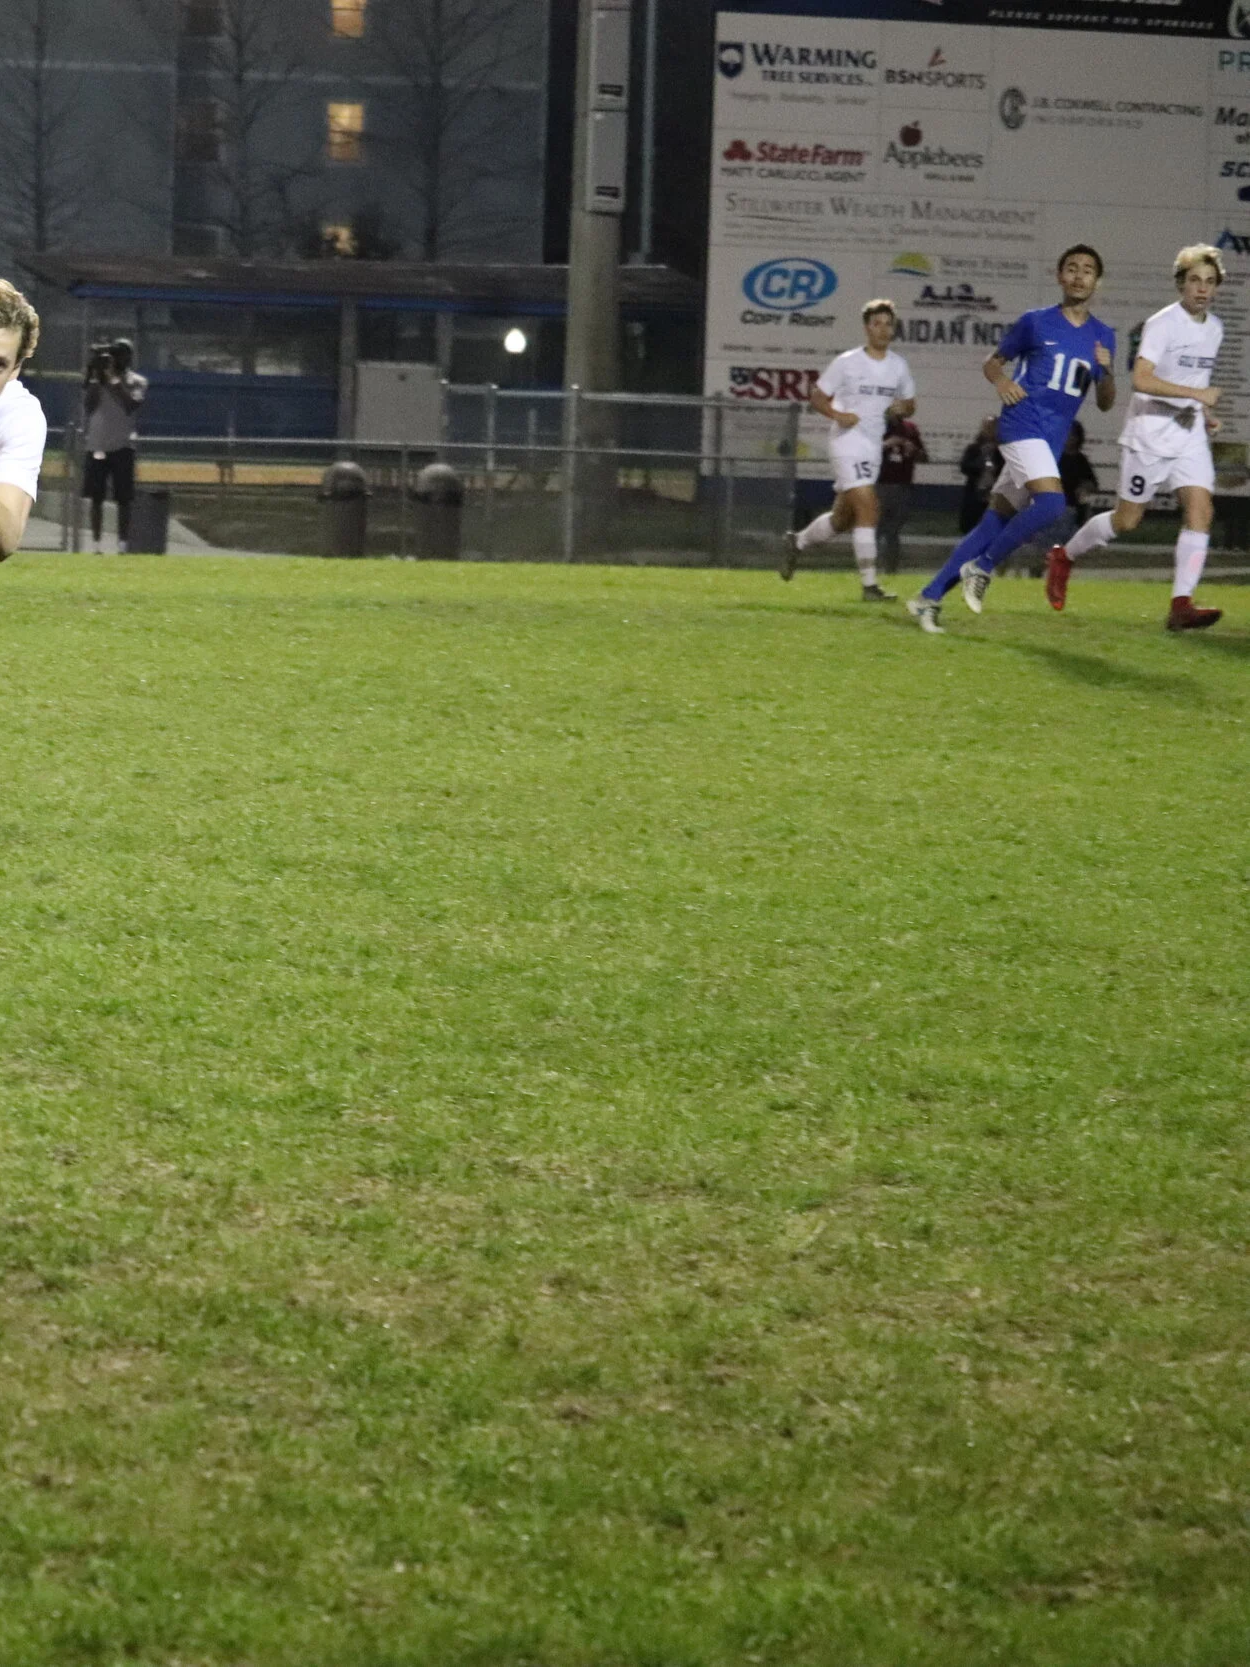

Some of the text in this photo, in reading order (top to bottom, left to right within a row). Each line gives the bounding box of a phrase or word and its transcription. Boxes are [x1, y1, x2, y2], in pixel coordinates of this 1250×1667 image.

[751, 43, 877, 69] WARMING
[761, 268, 819, 300] CR
[1047, 353, 1092, 397] 10
[854, 461, 872, 480] 15
[1130, 475, 1145, 496] 9
